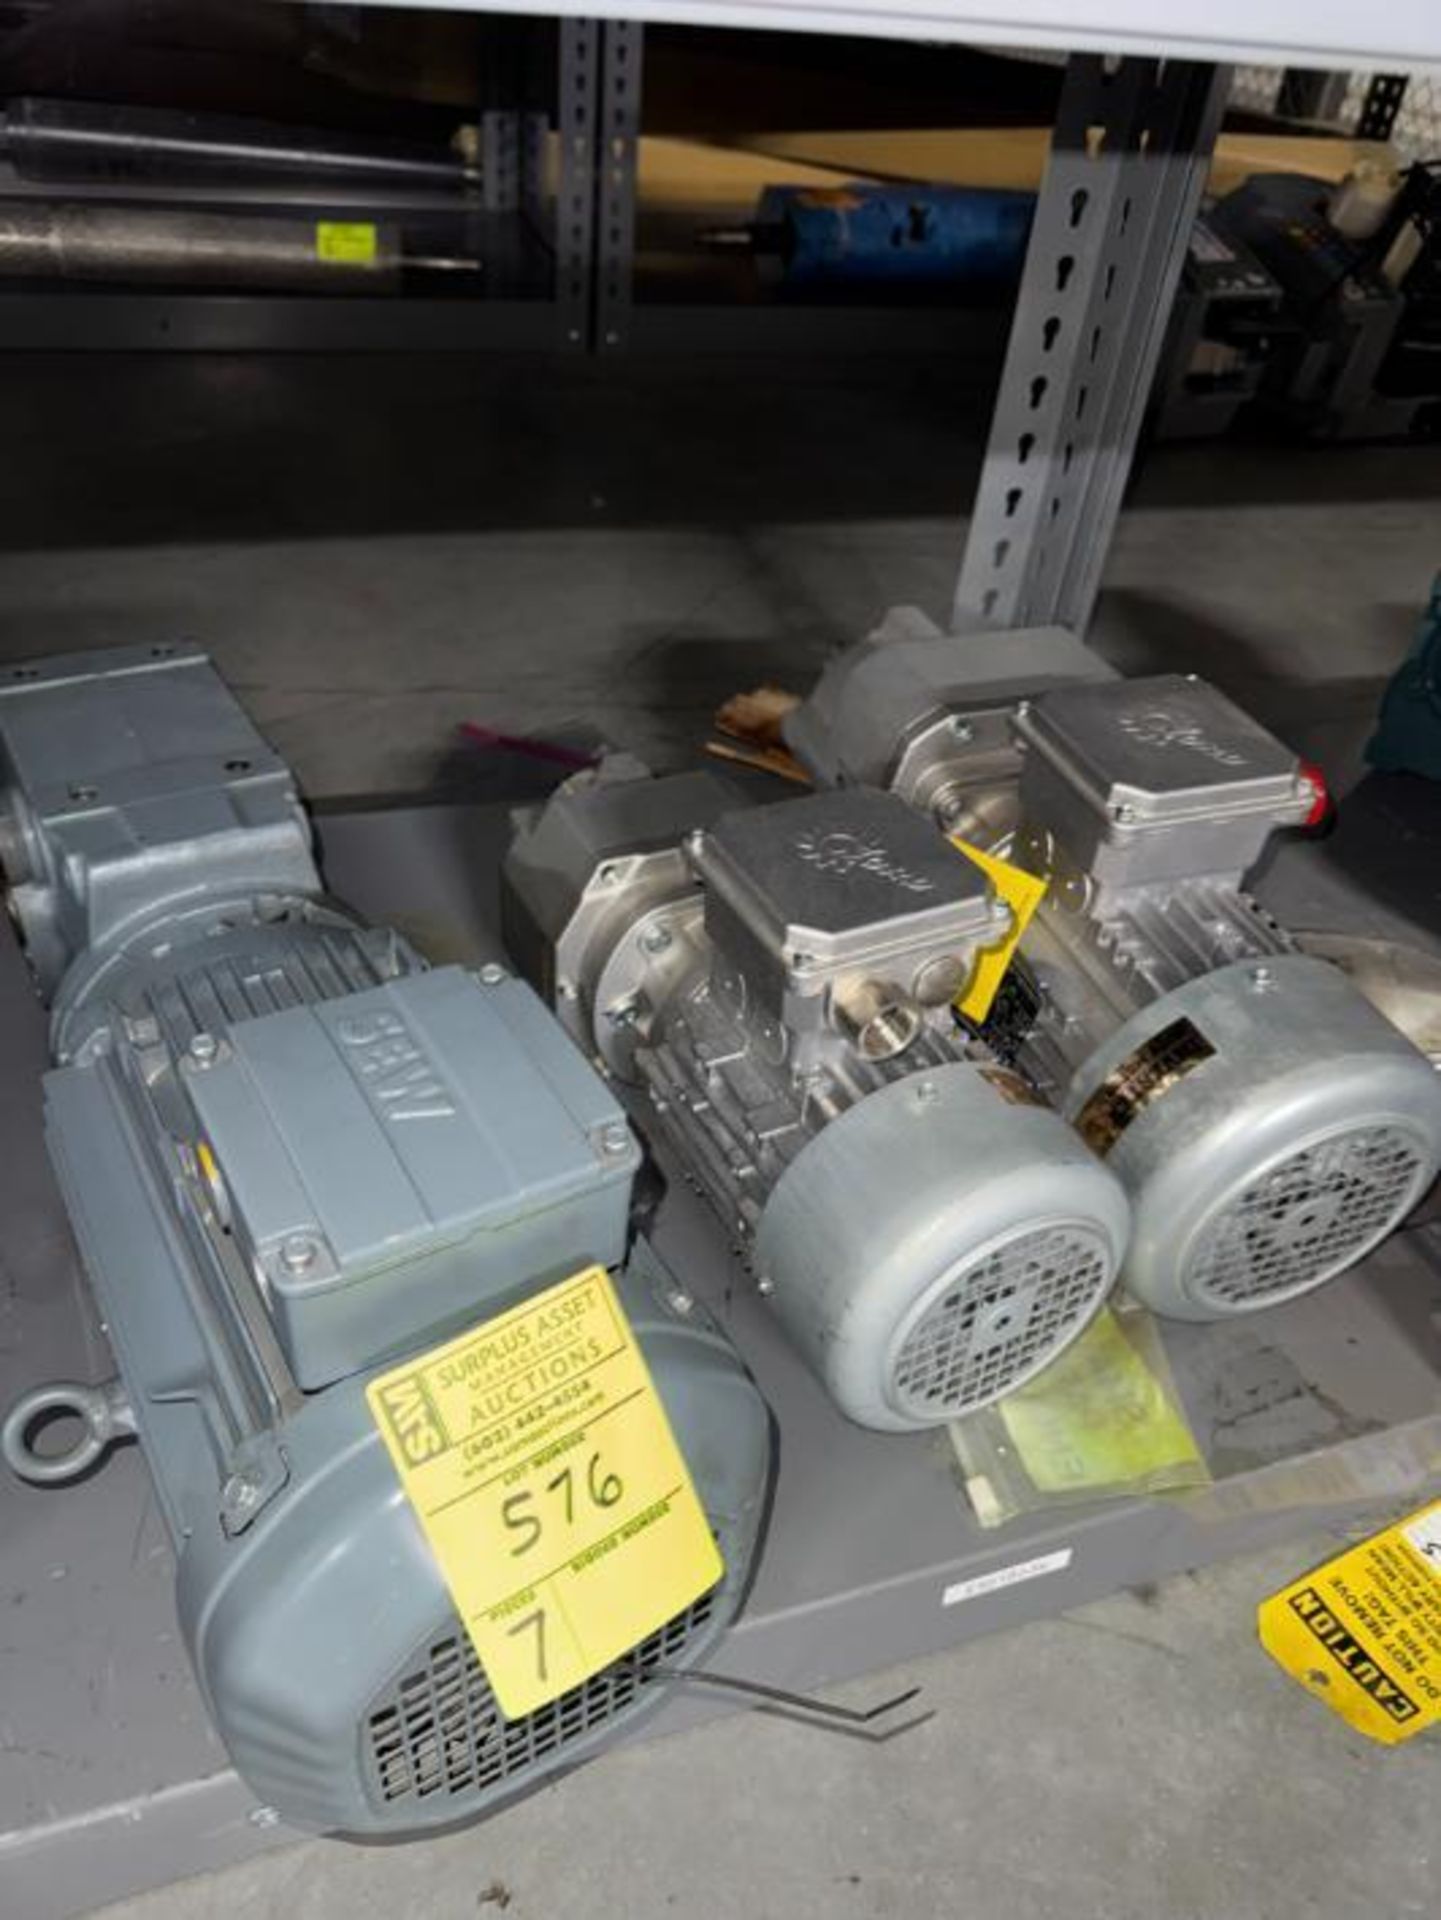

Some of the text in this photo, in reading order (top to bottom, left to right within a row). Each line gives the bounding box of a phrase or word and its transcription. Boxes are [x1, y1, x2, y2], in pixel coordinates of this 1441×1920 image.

[437, 1289, 594, 1389] SURPLUS ASSET
[468, 1321, 583, 1390] MANAGEMENT
[470, 1337, 601, 1427] AUCTIONS
[501, 1451, 624, 1557] 576
[1329, 1578, 1386, 1639] REMOVE
[507, 1607, 547, 1683] 7
[1293, 1592, 1417, 1719] CAUTION
[1384, 1642, 1414, 1673] NOT
[1396, 1629, 1429, 1666] THIS
[1416, 1675, 1440, 1699] DO
